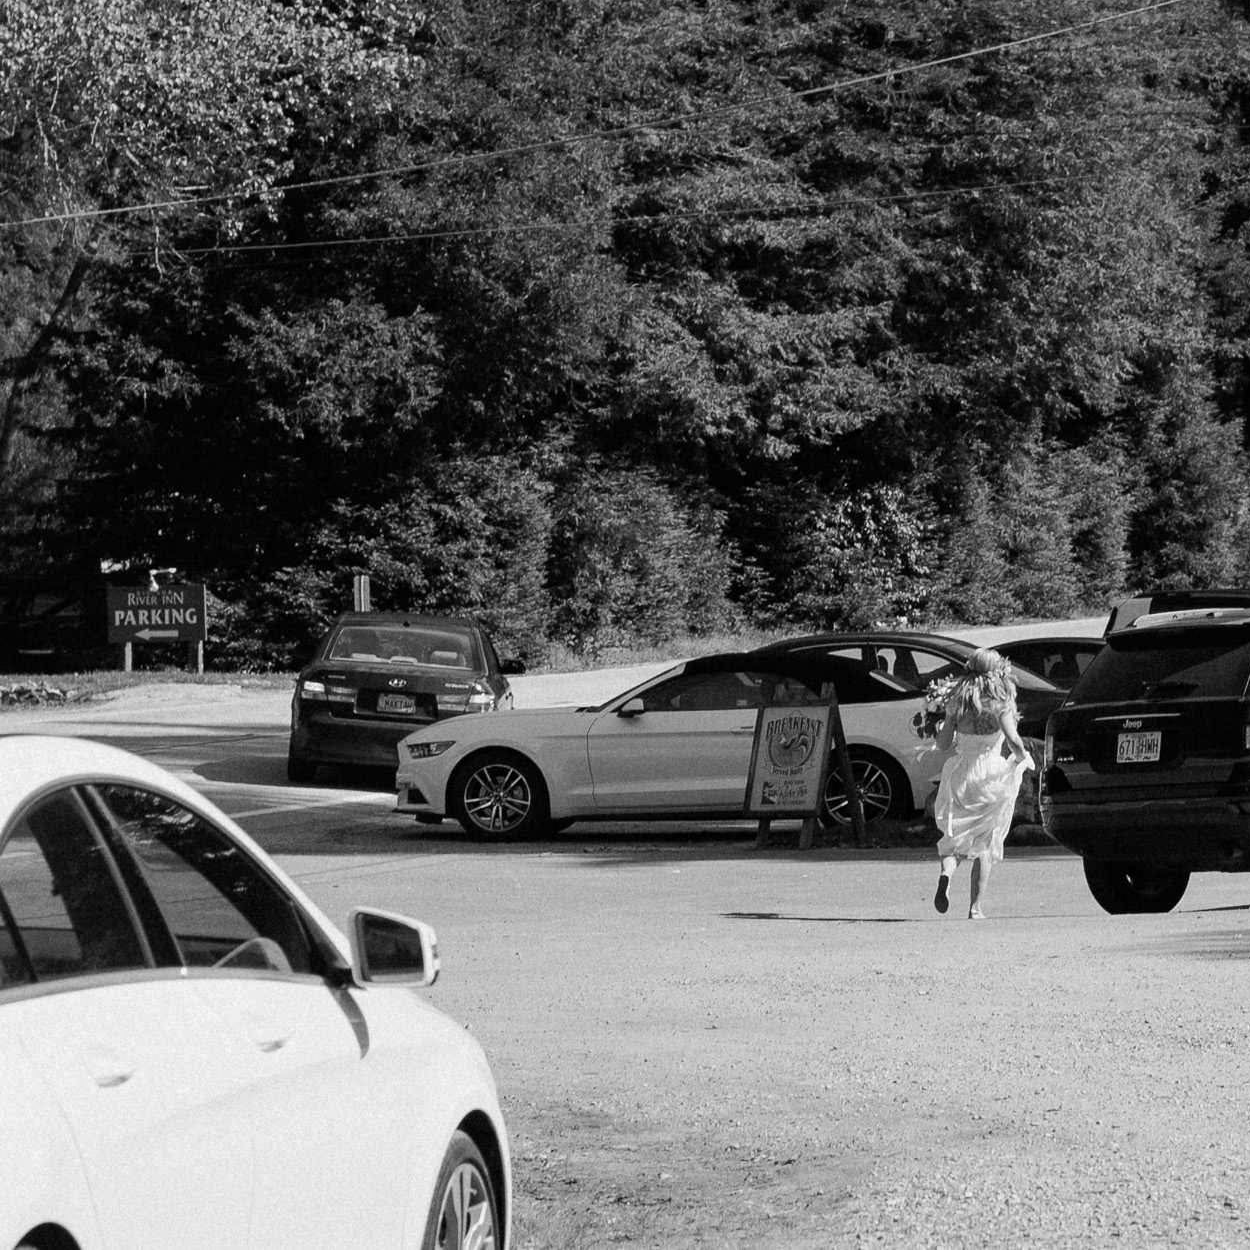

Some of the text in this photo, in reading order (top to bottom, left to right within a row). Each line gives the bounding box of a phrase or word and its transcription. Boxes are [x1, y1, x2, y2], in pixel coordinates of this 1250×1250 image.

[127, 592, 158, 606] RIVER
[162, 591, 184, 605] INN
[114, 608, 198, 627] PARKING
[765, 716, 824, 741] BREAKFAST
[1122, 719, 1143, 730] Jeep
[1119, 736, 1159, 756] 671 HWH
